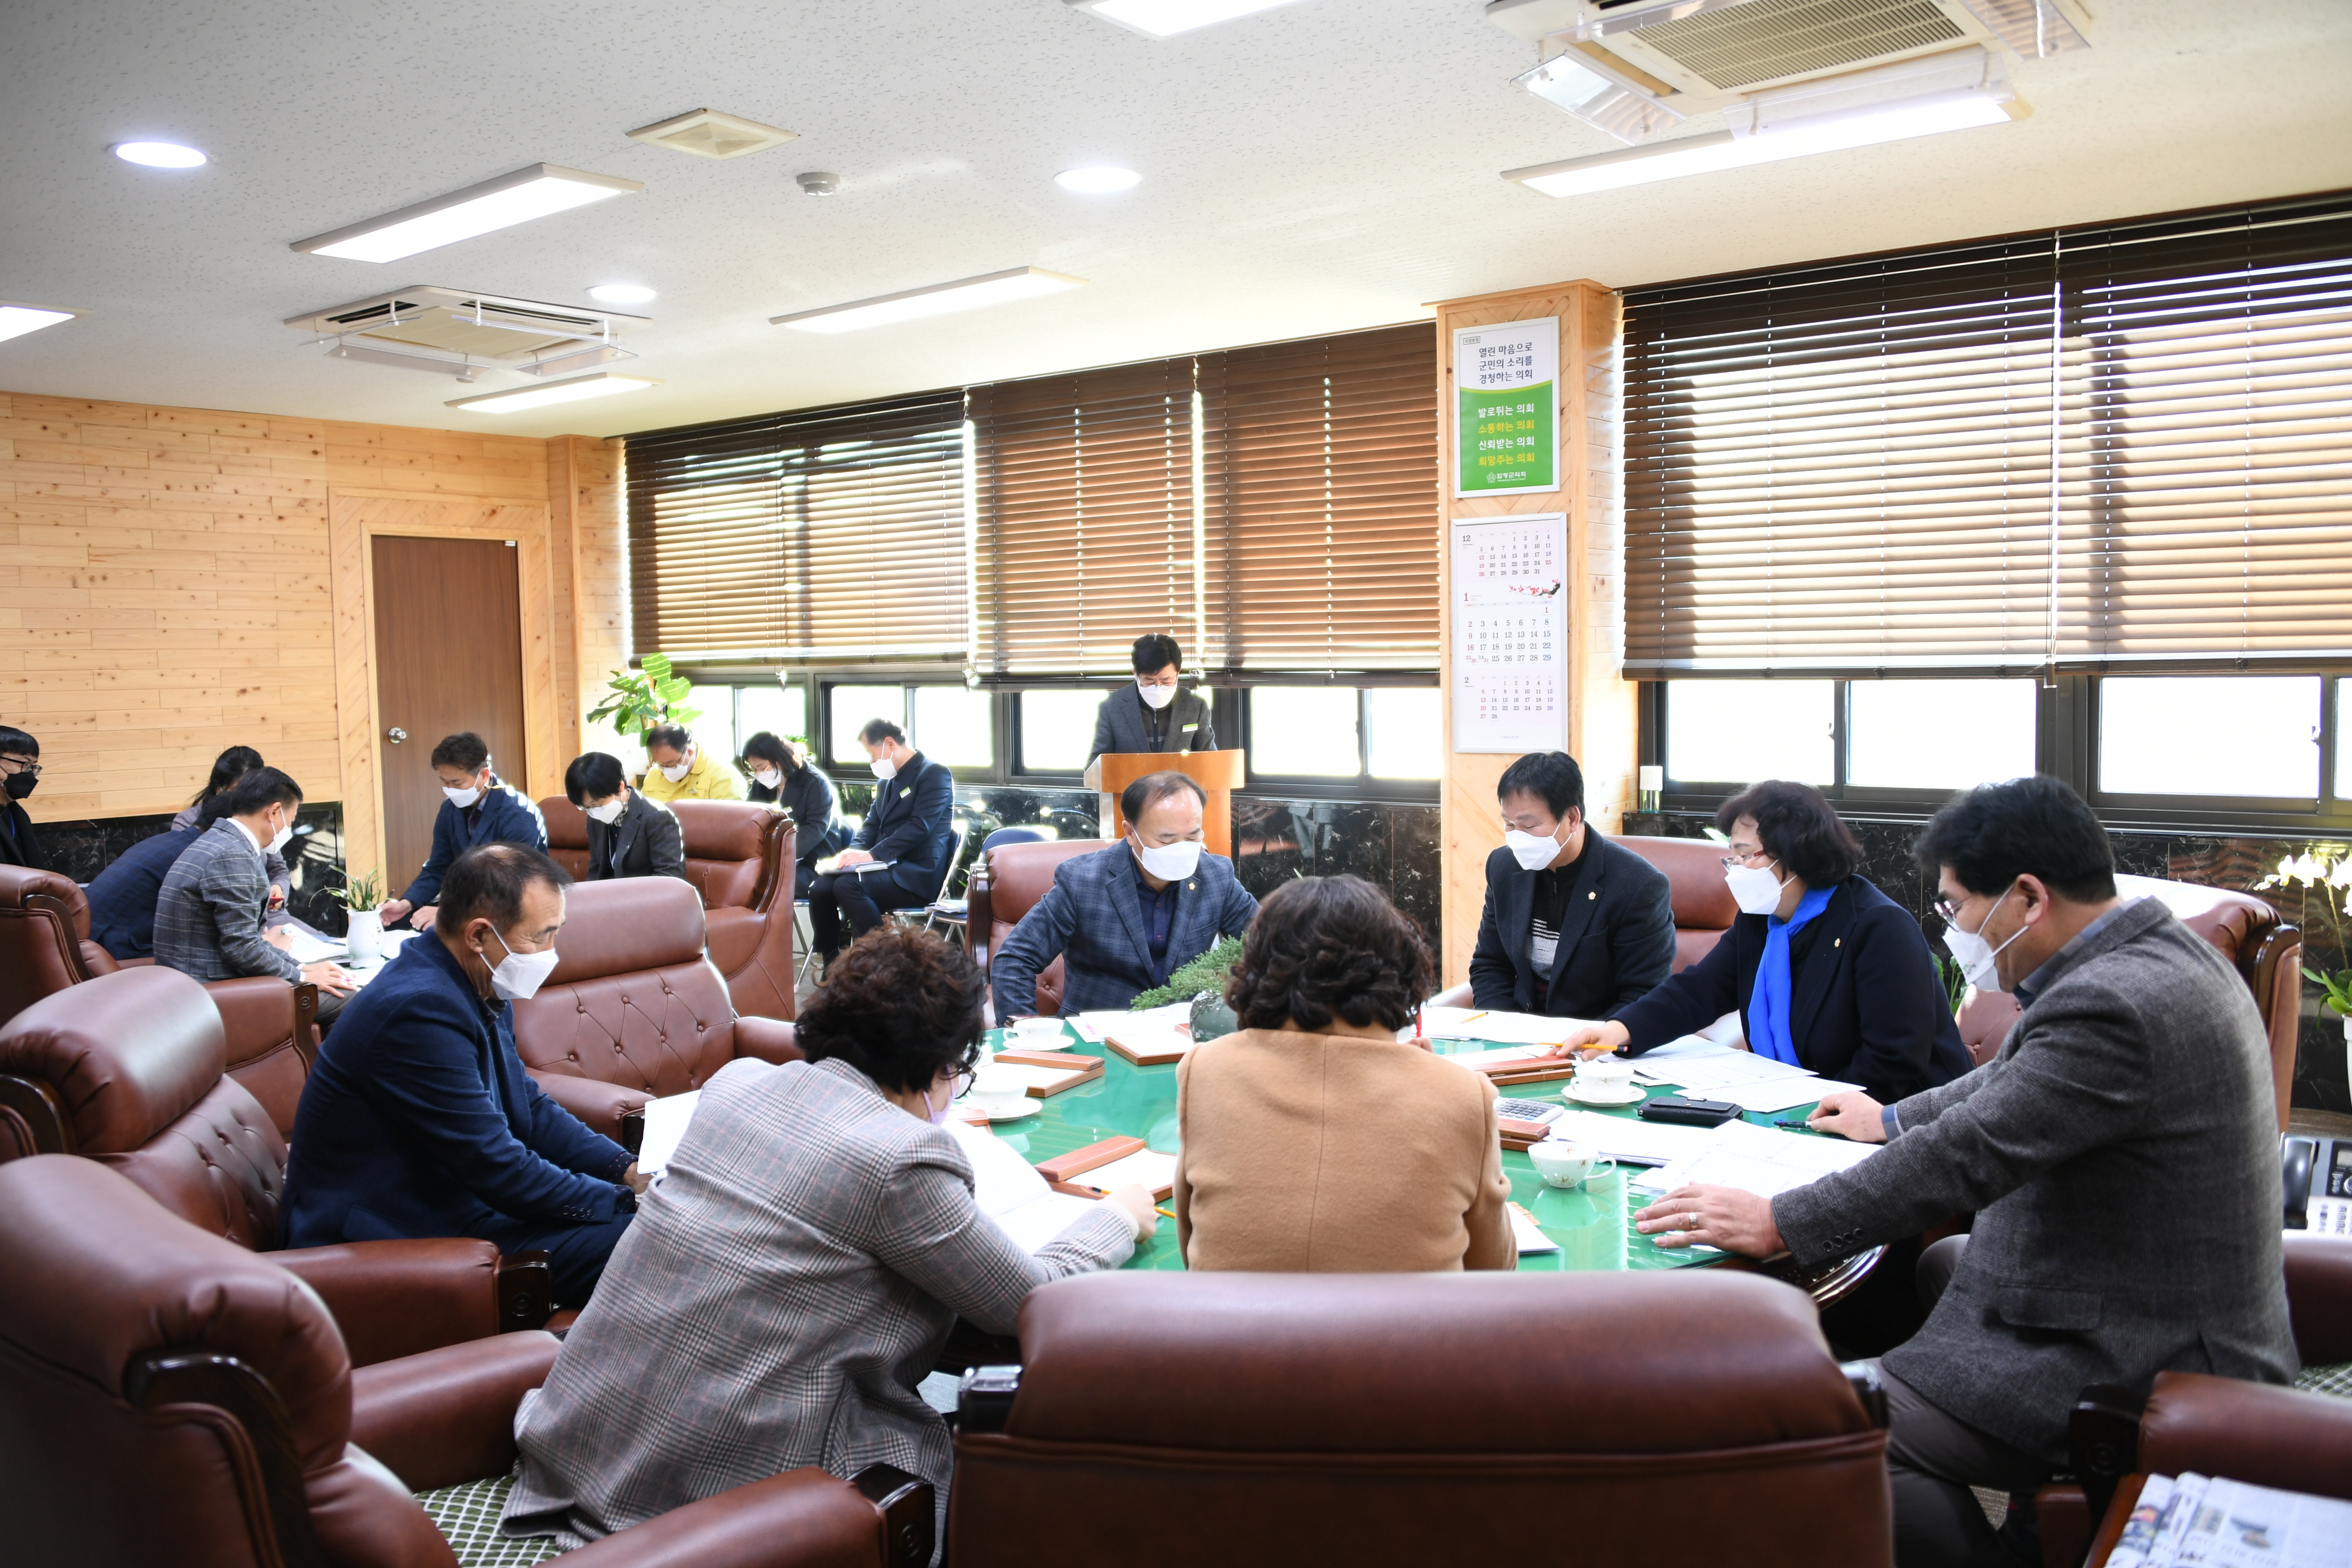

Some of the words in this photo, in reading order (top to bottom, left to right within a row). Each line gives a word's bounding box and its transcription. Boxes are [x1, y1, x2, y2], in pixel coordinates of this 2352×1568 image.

[1479, 346, 1495, 358] 열린
[1498, 342, 1533, 355] 마음으로
[1479, 359, 1504, 370] 군민의
[1507, 356, 1533, 366] 소리를
[1479, 372, 1513, 384] 경청하는
[1516, 369, 1533, 379] 의회
[1478, 406, 1514, 418] 발로뛰는
[1516, 403, 1534, 414] 의회
[1478, 422, 1513, 433] 소통하는
[1517, 420, 1534, 430] 의회
[1479, 439, 1513, 450] 신뢰받는
[1517, 436, 1534, 446] 의회
[1479, 455, 1514, 466] 희망주는
[1517, 453, 1534, 463] 의회
[1464, 593, 1469, 601] 1
